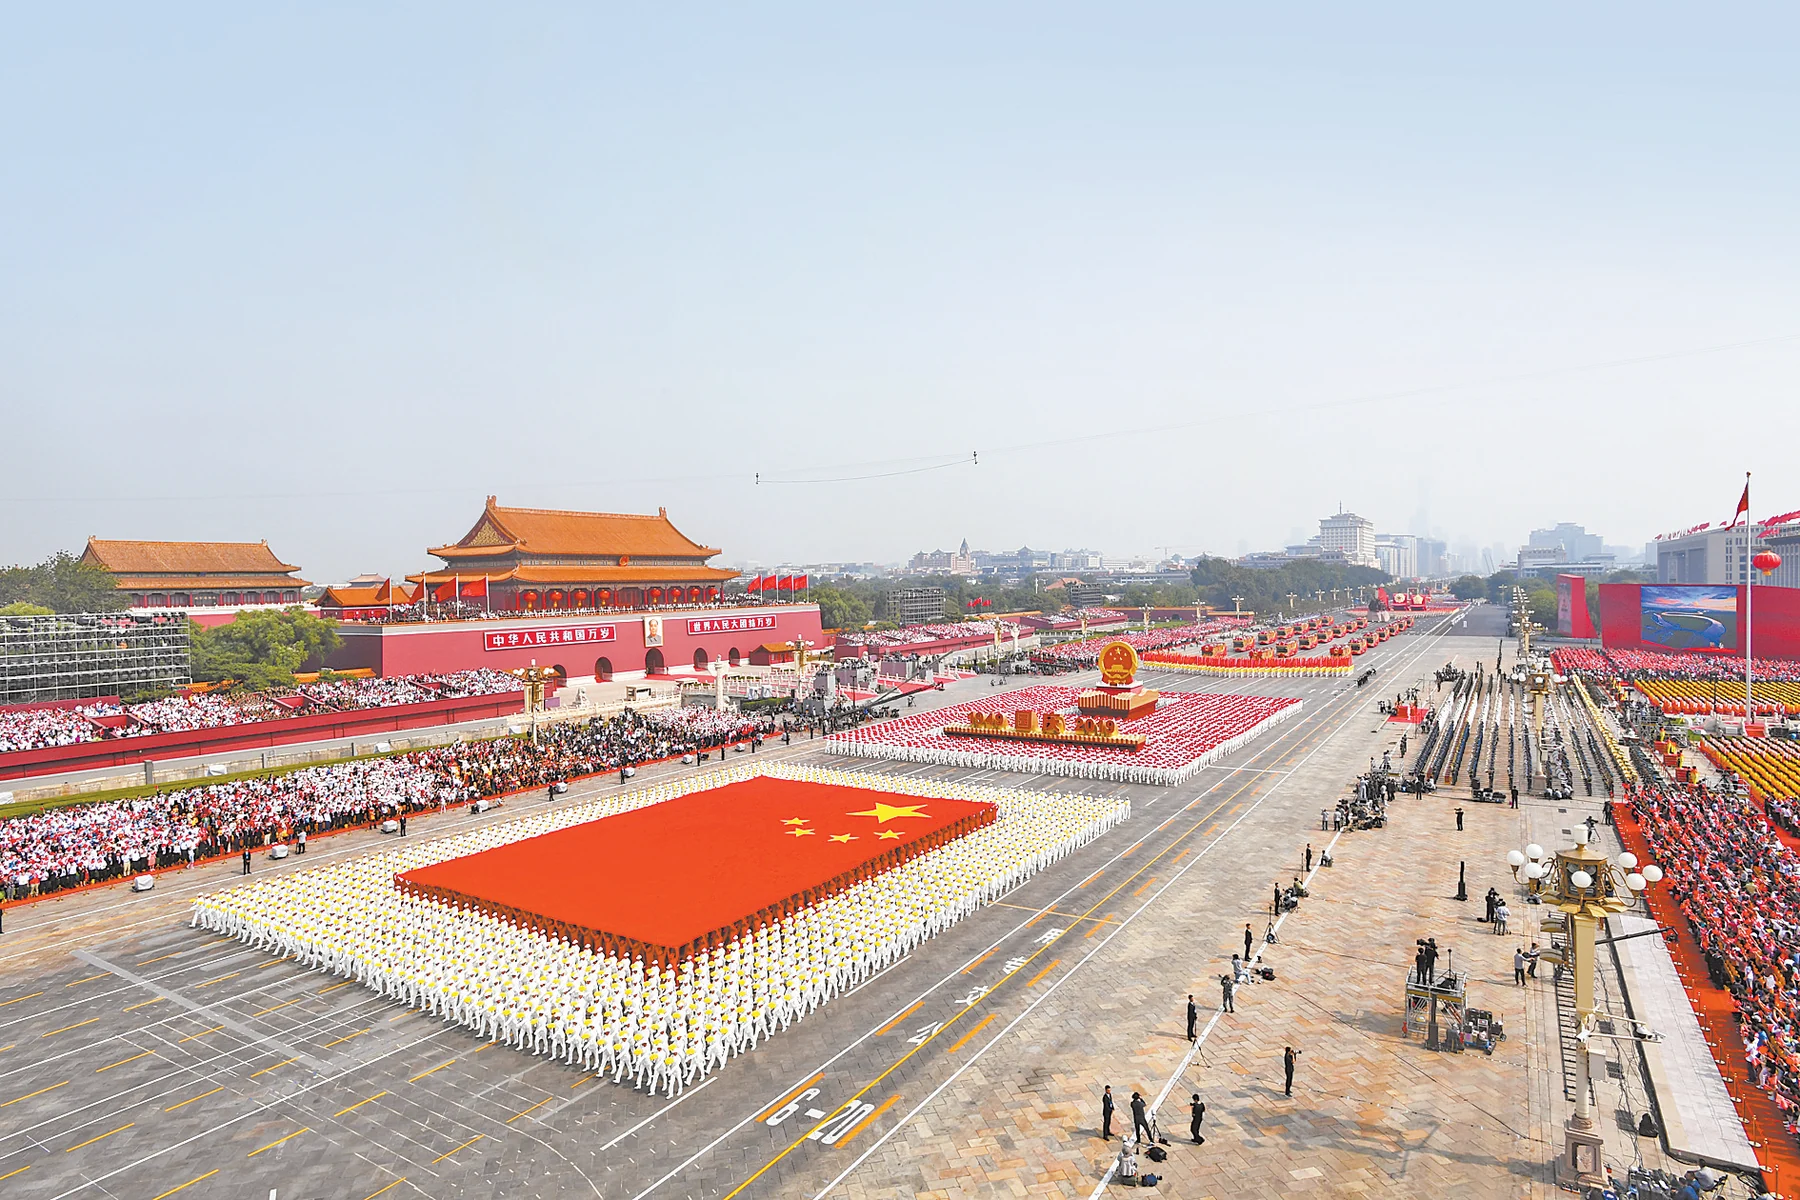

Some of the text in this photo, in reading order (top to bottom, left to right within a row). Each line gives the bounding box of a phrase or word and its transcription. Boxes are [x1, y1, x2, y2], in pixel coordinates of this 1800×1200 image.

[693, 617, 772, 632] 世界人民大团结万岁
[492, 627, 609, 646] 中华人民共和国万岁
[967, 710, 1117, 735] 1949 国庆 2019
[766, 1088, 875, 1144] 6-20
